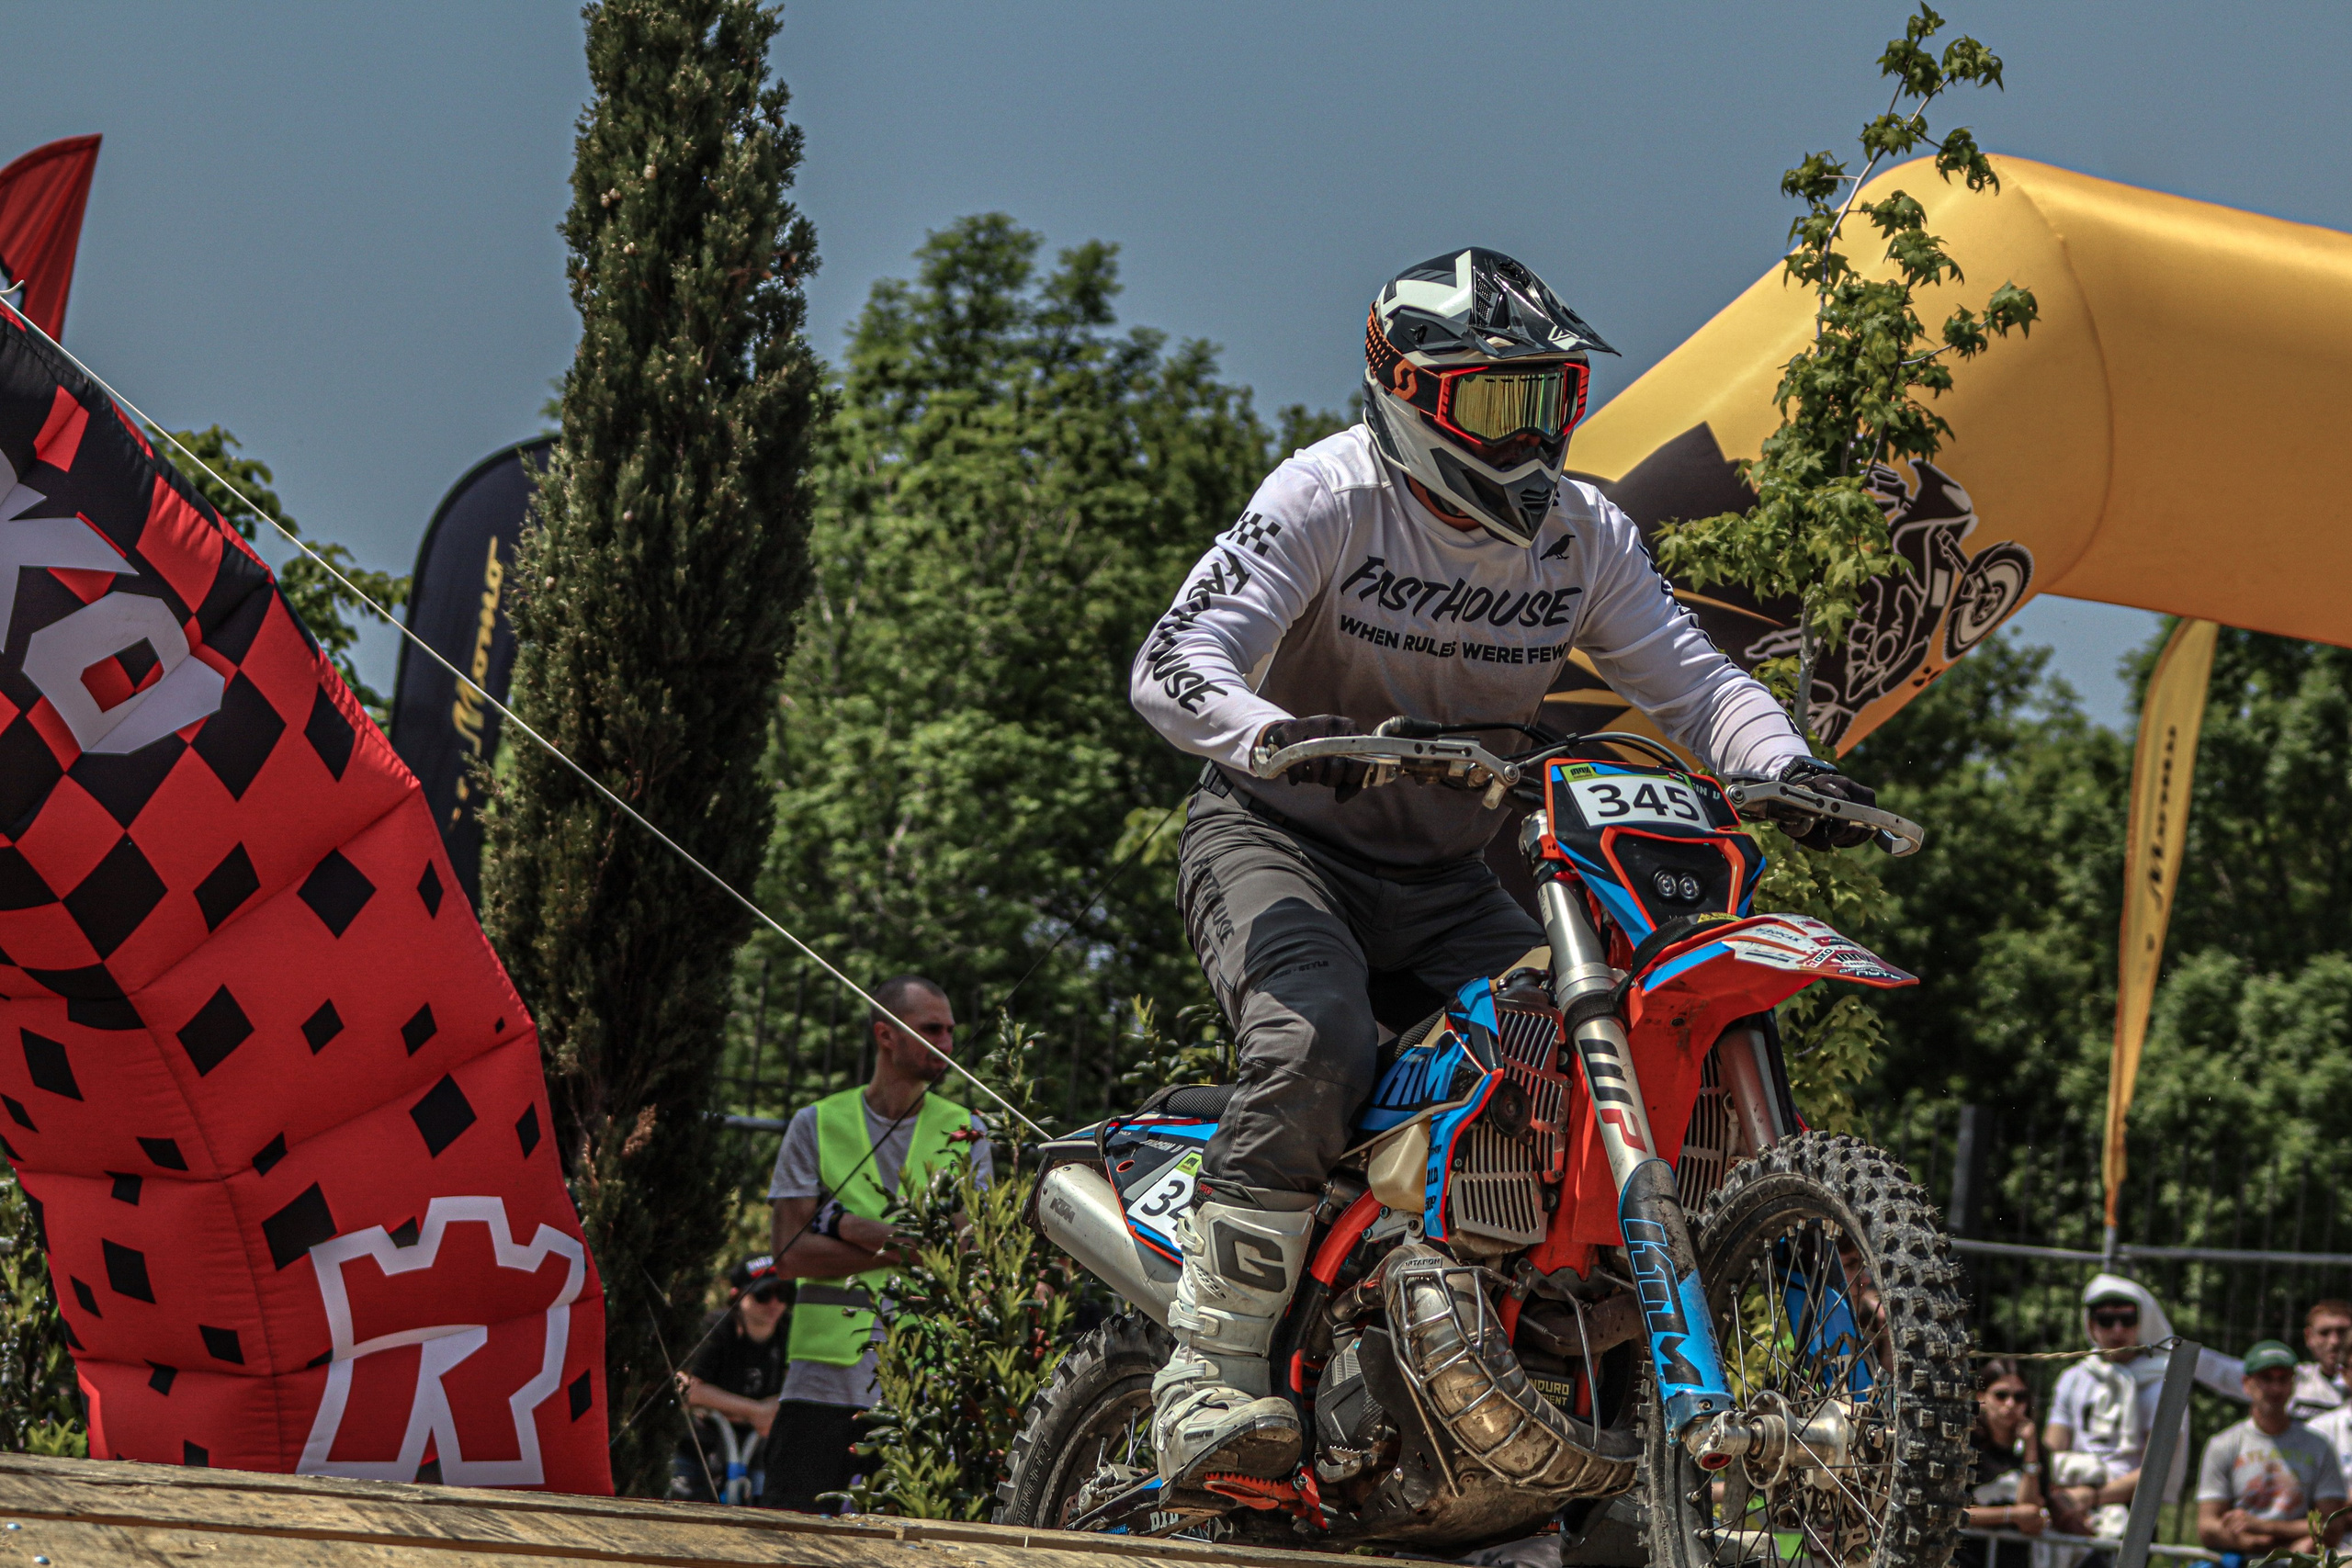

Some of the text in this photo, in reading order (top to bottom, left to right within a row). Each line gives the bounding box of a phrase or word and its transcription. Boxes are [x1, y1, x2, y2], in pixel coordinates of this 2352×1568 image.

[1340, 555, 1582, 627] FASTHOUSE
[1340, 615, 1400, 649] WHEN
[1462, 642, 1523, 664] WERE
[1527, 642, 1569, 664] FEW
[1588, 783, 1700, 821] 345
[1049, 1197, 1076, 1224] KTM
[1623, 1218, 1703, 1386] KTM
[1529, 1378, 1570, 1396] NDURO
